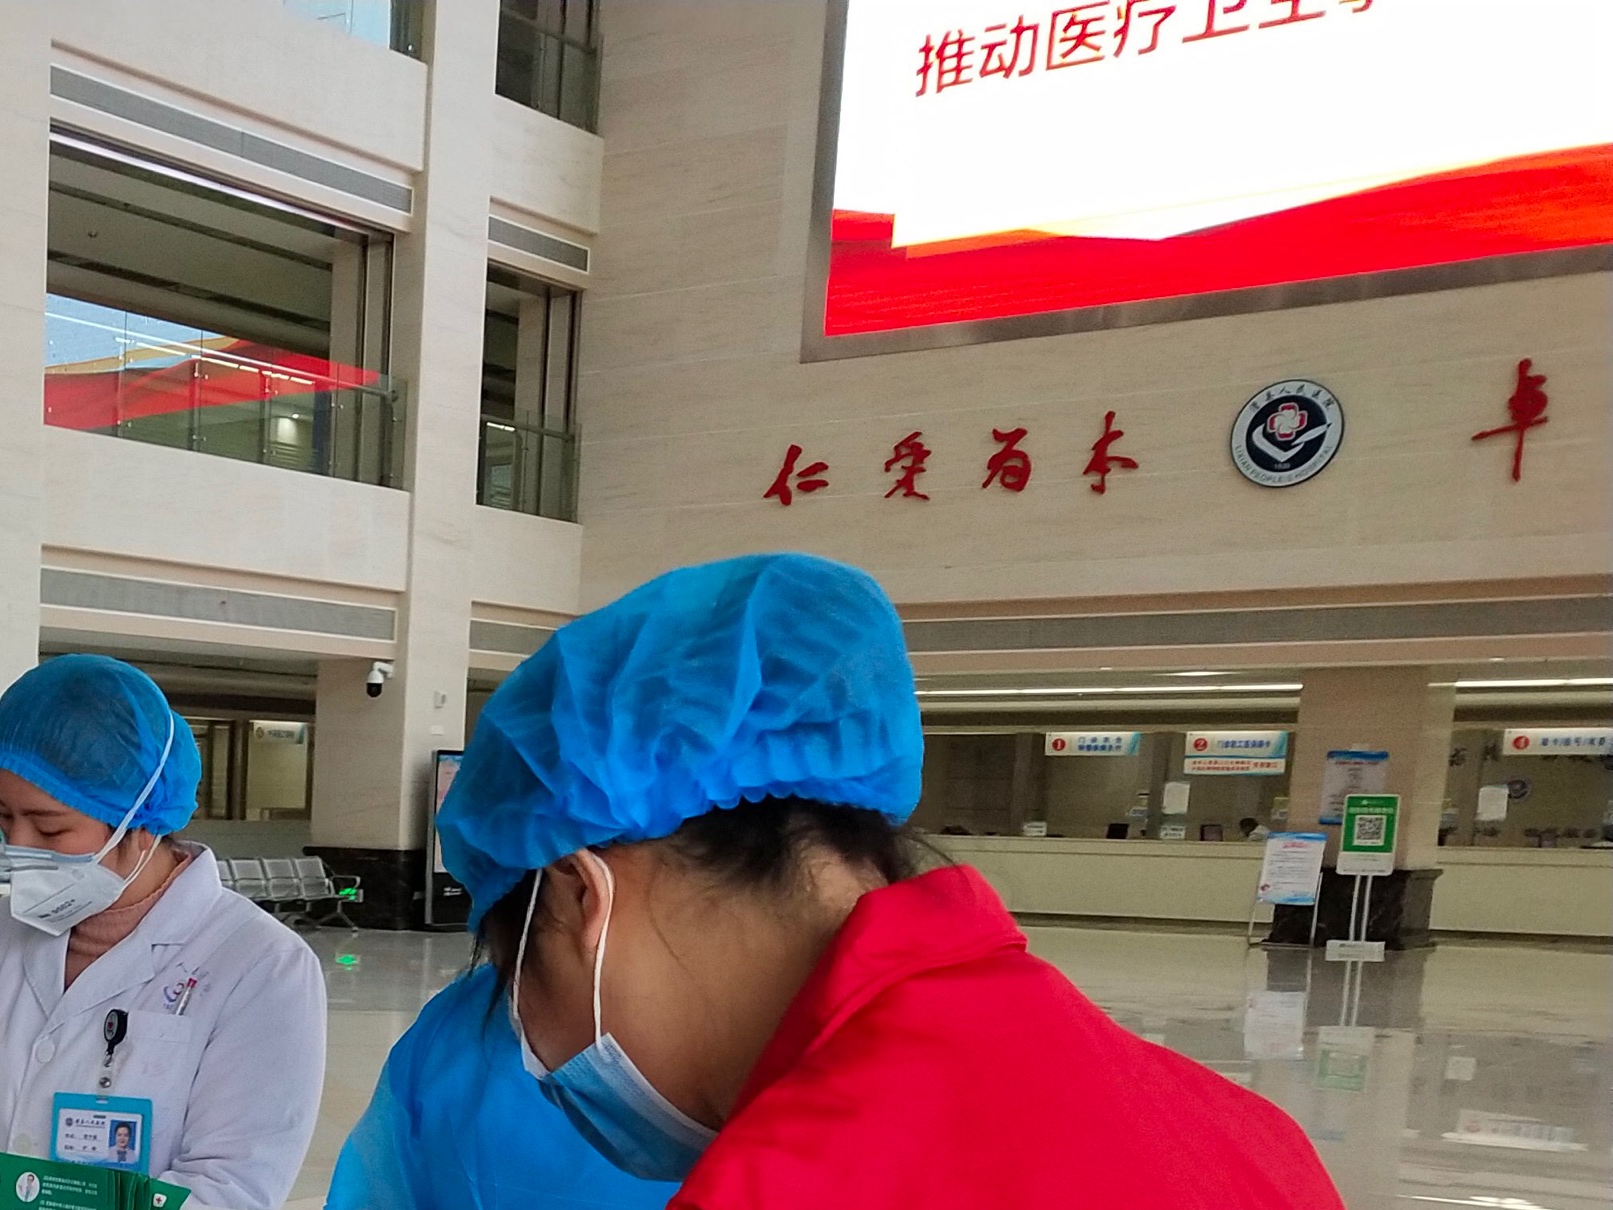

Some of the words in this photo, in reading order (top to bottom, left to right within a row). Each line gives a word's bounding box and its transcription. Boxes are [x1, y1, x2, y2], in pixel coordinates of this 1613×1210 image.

[915, 0, 1372, 97] 推动医疗卫
